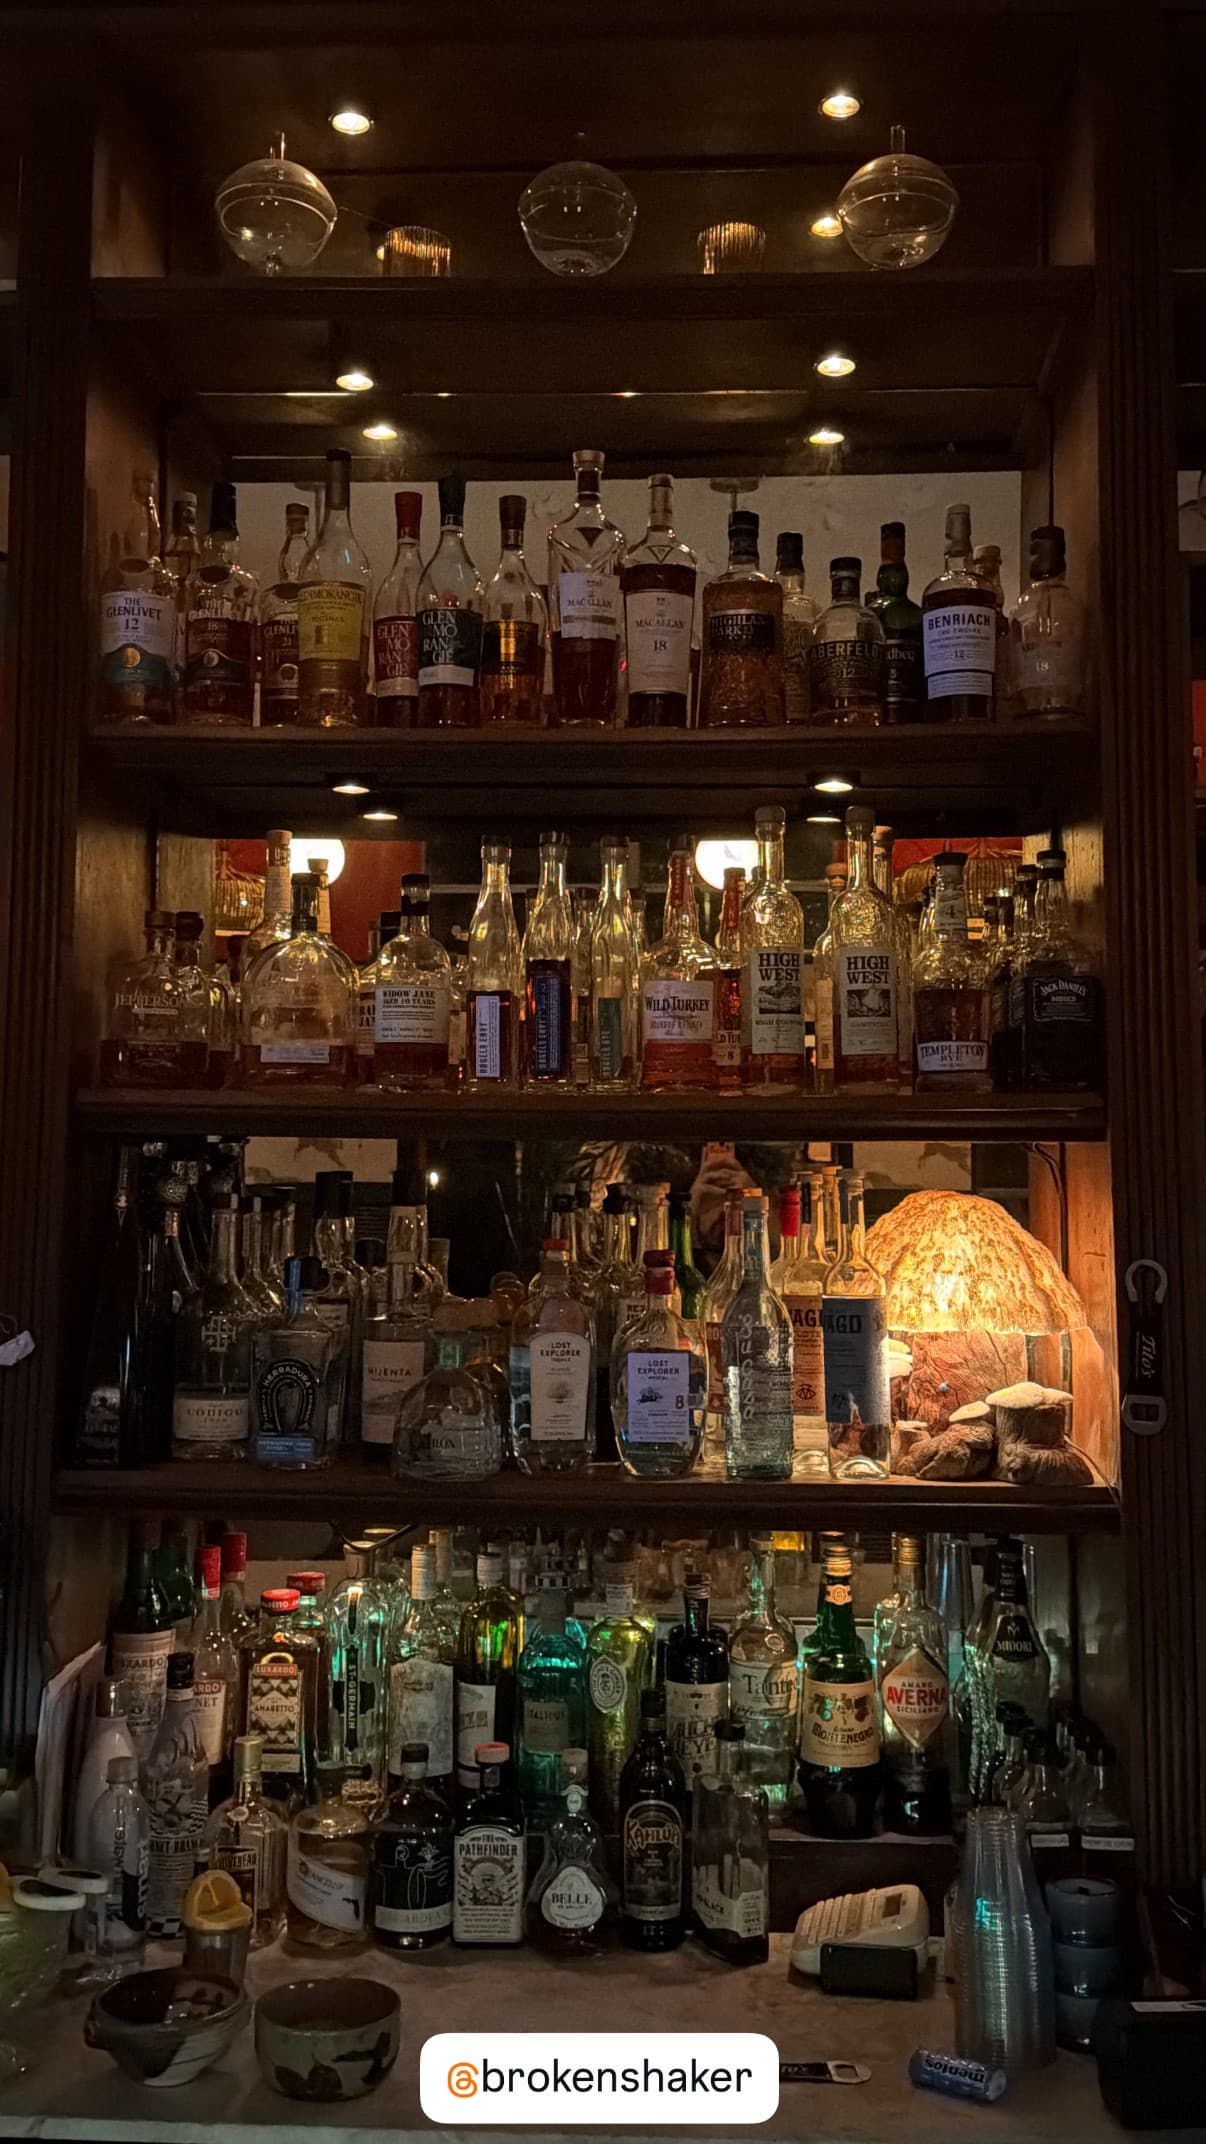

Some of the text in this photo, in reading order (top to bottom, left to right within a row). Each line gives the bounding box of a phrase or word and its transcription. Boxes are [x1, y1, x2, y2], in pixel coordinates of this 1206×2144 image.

[124, 598, 143, 606] THE
[105, 606, 161, 621] GLENLIVET
[421, 609, 458, 625] GLEN
[124, 617, 140, 631] 12
[635, 618, 685, 630] MACALLAN
[928, 612, 991, 631] BENRIACH
[431, 624, 458, 638] MO
[387, 639, 411, 651] MO
[653, 639, 668, 653] 18
[811, 641, 880, 661] ABERFELD
[954, 649, 966, 659] 12
[758, 953, 800, 967] HIGH
[847, 955, 890, 969] HIGH
[759, 968, 800, 981] WEST
[847, 971, 890, 984] WEST
[646, 998, 709, 1012] WILD TURKEY
[920, 1044, 985, 1058] TEMPLETON
[824, 1314, 863, 1334] AGO
[550, 1341, 571, 1349] LOST
[539, 1350, 581, 1358] EXPLORER
[1141, 1335, 1156, 1380] Tito's
[262, 1366, 313, 1389] HERRADURA
[637, 1367, 680, 1375] EXPLORER
[674, 1394, 685, 1409] 8
[997, 1639, 1033, 1653] MIDORI
[256, 1666, 296, 1675] LUXARDO
[195, 1698, 219, 1708] NET
[886, 1686, 946, 1706] AVERNA
[482, 1834, 494, 1844] THE
[459, 1843, 518, 1857] PATHFINDER
[551, 1893, 592, 1905] BELLE
[924, 2056, 985, 2084] mentos
